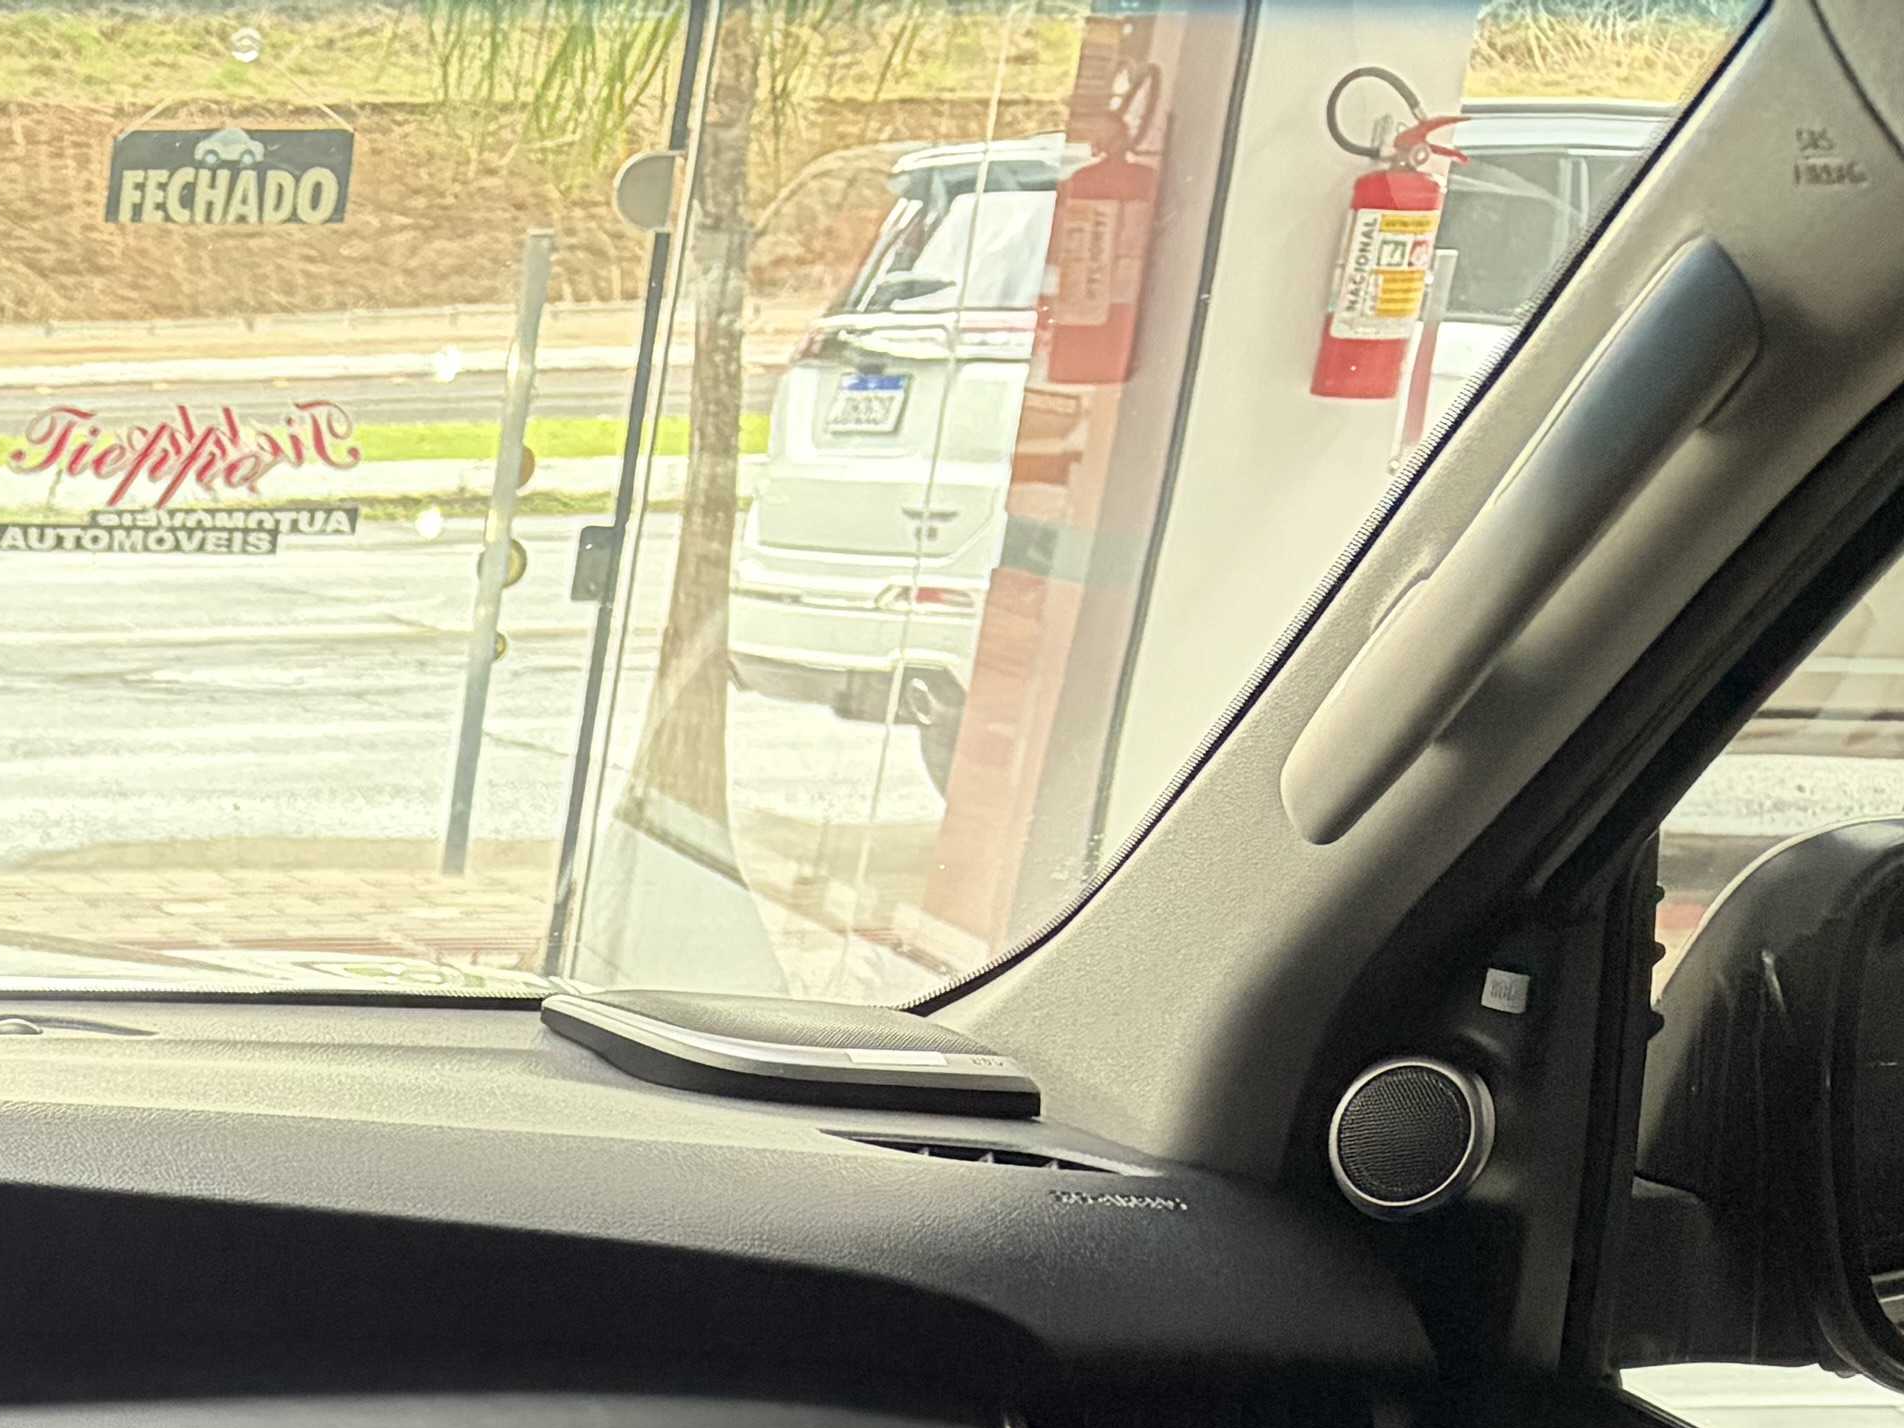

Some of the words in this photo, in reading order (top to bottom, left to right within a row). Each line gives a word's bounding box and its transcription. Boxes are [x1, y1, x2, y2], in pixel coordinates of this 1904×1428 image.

[119, 167, 339, 224] FECHADO
[1345, 217, 1378, 311] NACIONAL
[8, 405, 272, 508] Tieppo
[0, 526, 274, 554] AUTOMÓVEIS
